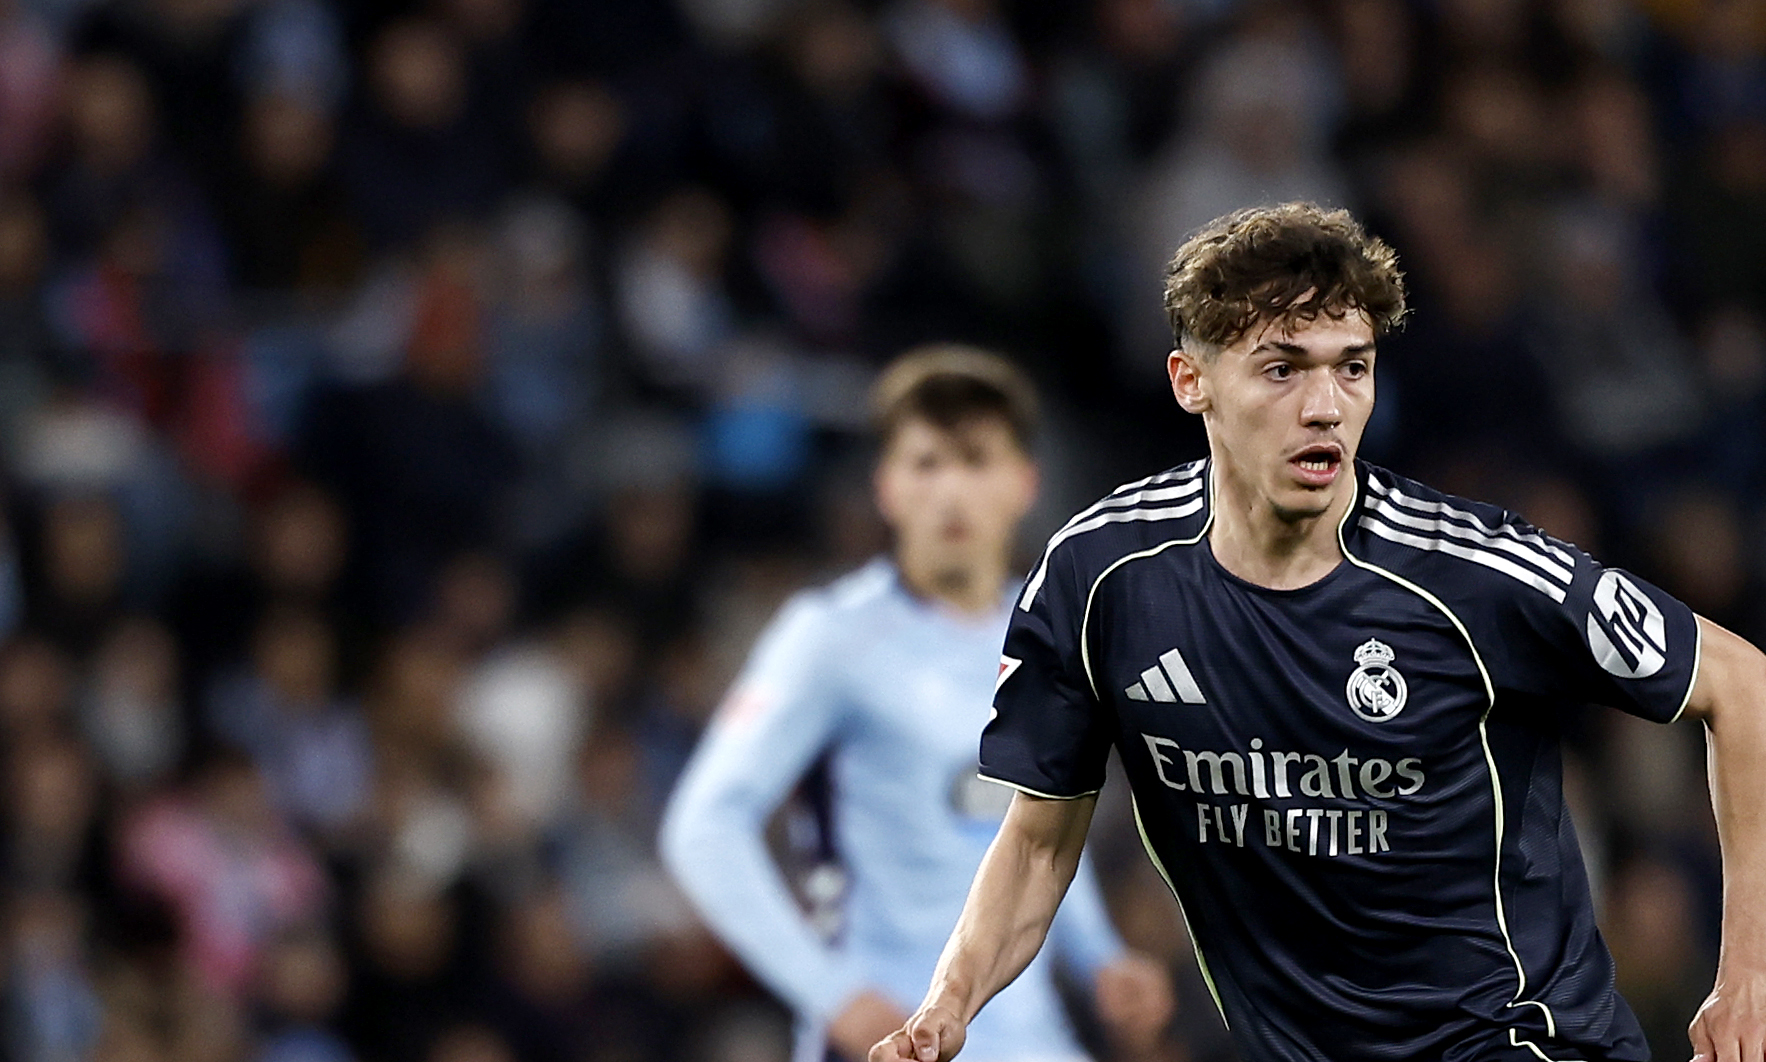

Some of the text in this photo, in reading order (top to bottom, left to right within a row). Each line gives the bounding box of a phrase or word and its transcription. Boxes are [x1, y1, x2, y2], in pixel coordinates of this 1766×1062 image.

[1141, 732, 1425, 799] Emirates
[1197, 802, 1390, 857] FLY BETTER
